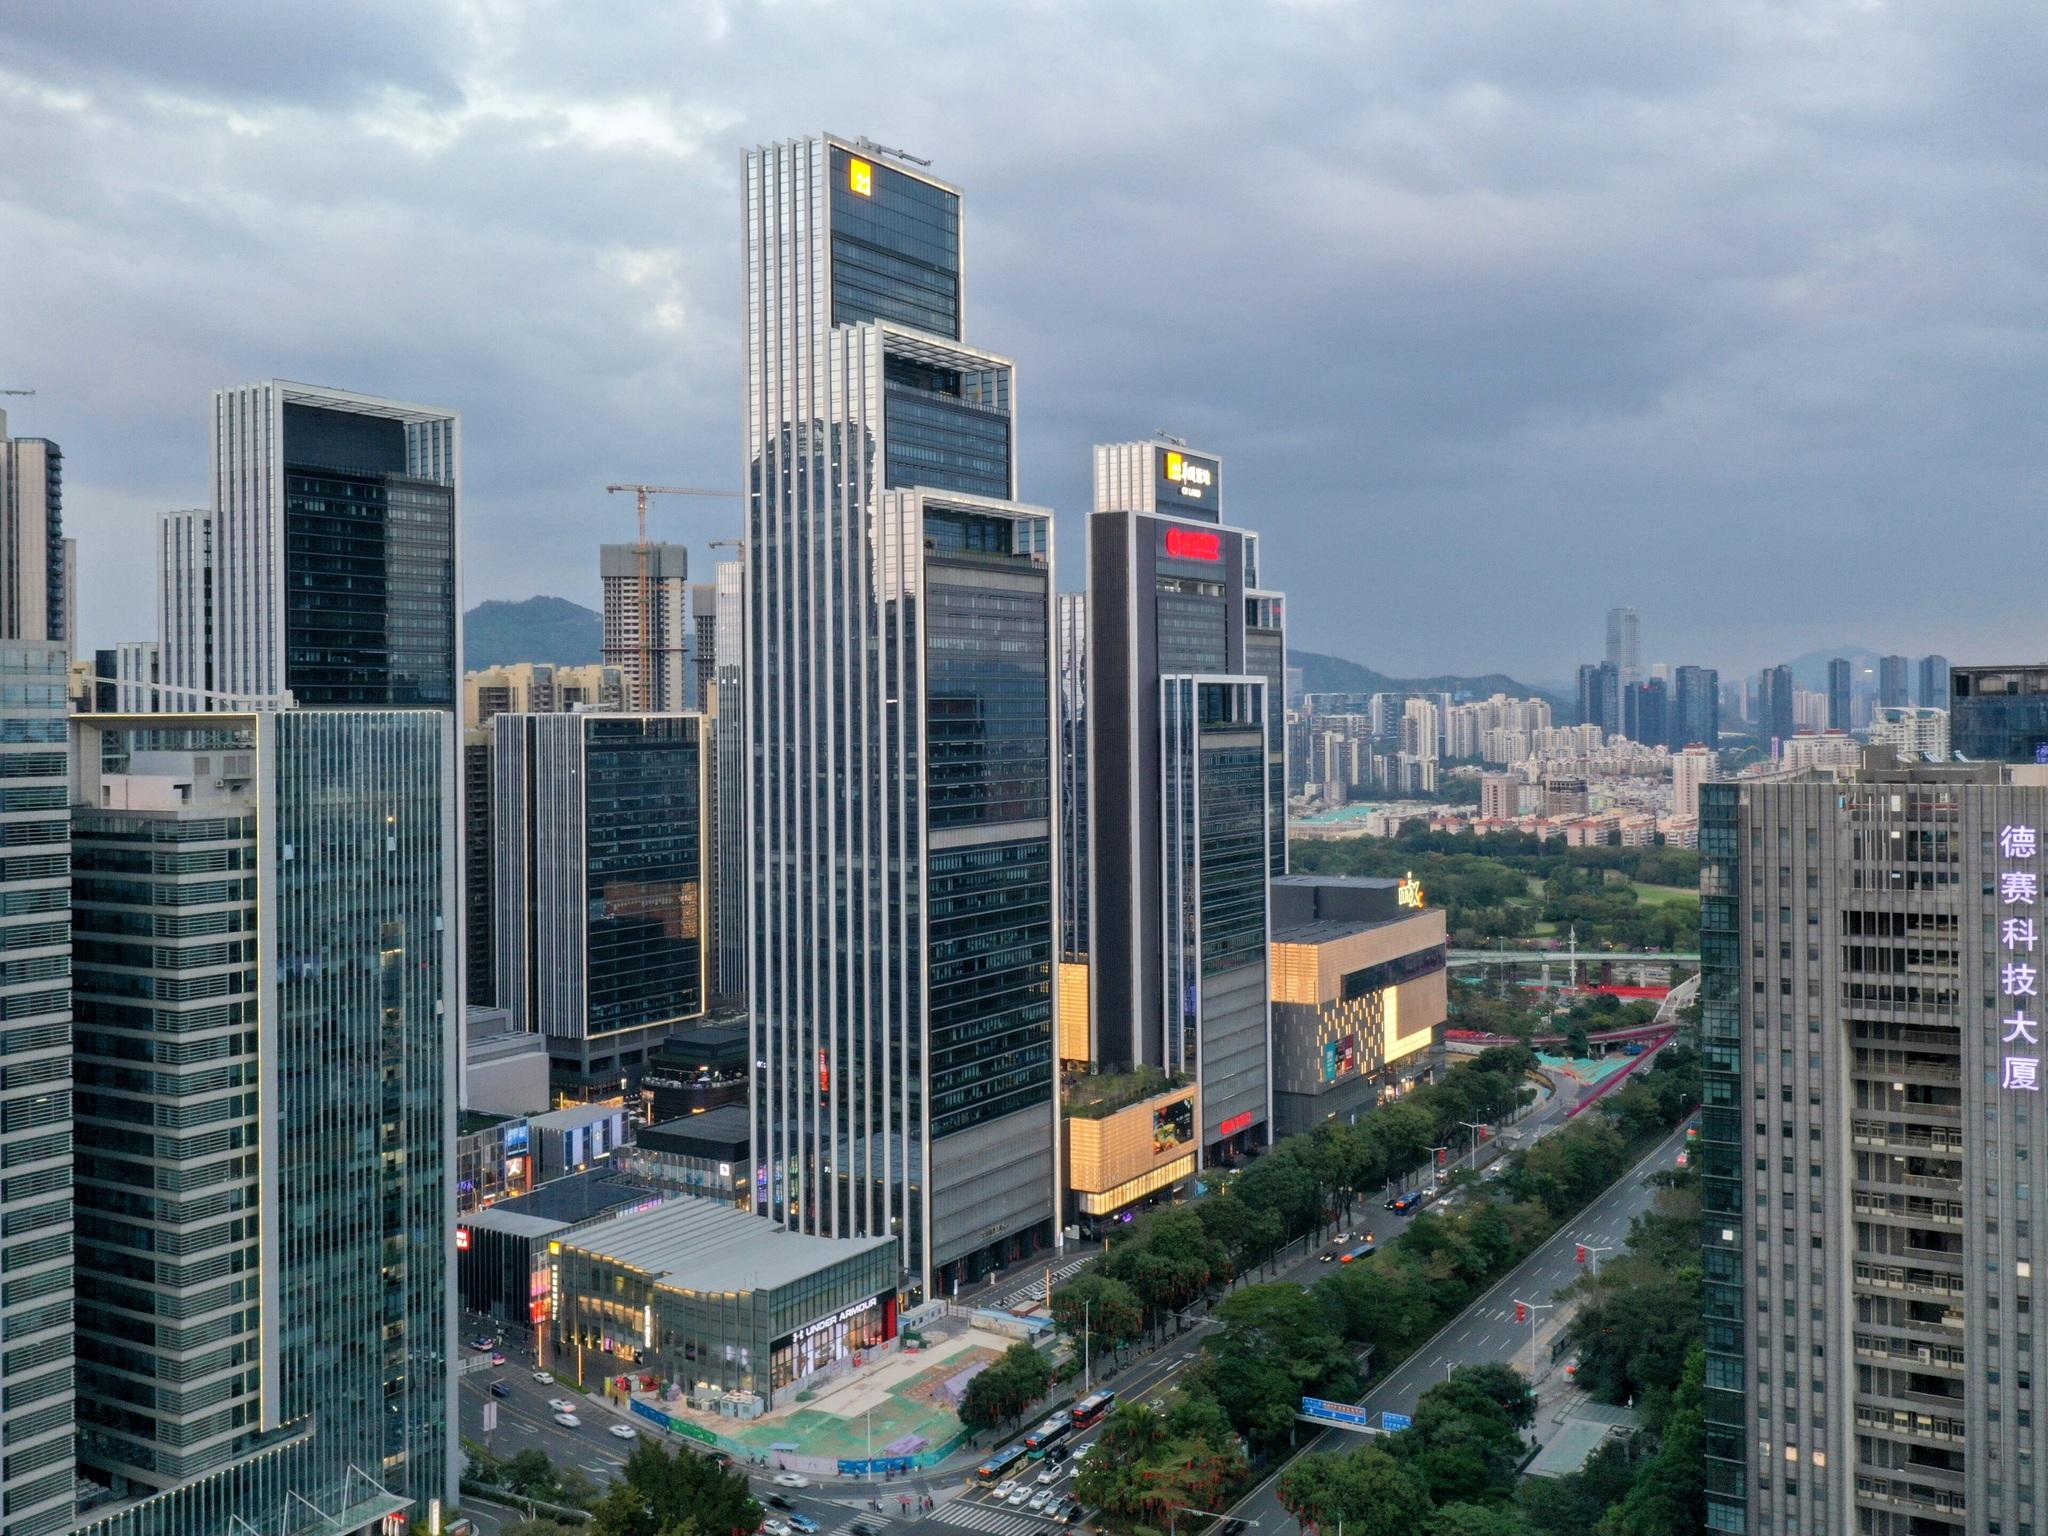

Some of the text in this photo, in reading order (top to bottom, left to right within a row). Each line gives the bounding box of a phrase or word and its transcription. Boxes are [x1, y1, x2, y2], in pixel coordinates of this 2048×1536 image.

[2000, 824, 2040, 1091] 德赛科技大厦
[806, 1297, 877, 1336] UNDER ARMOUR
